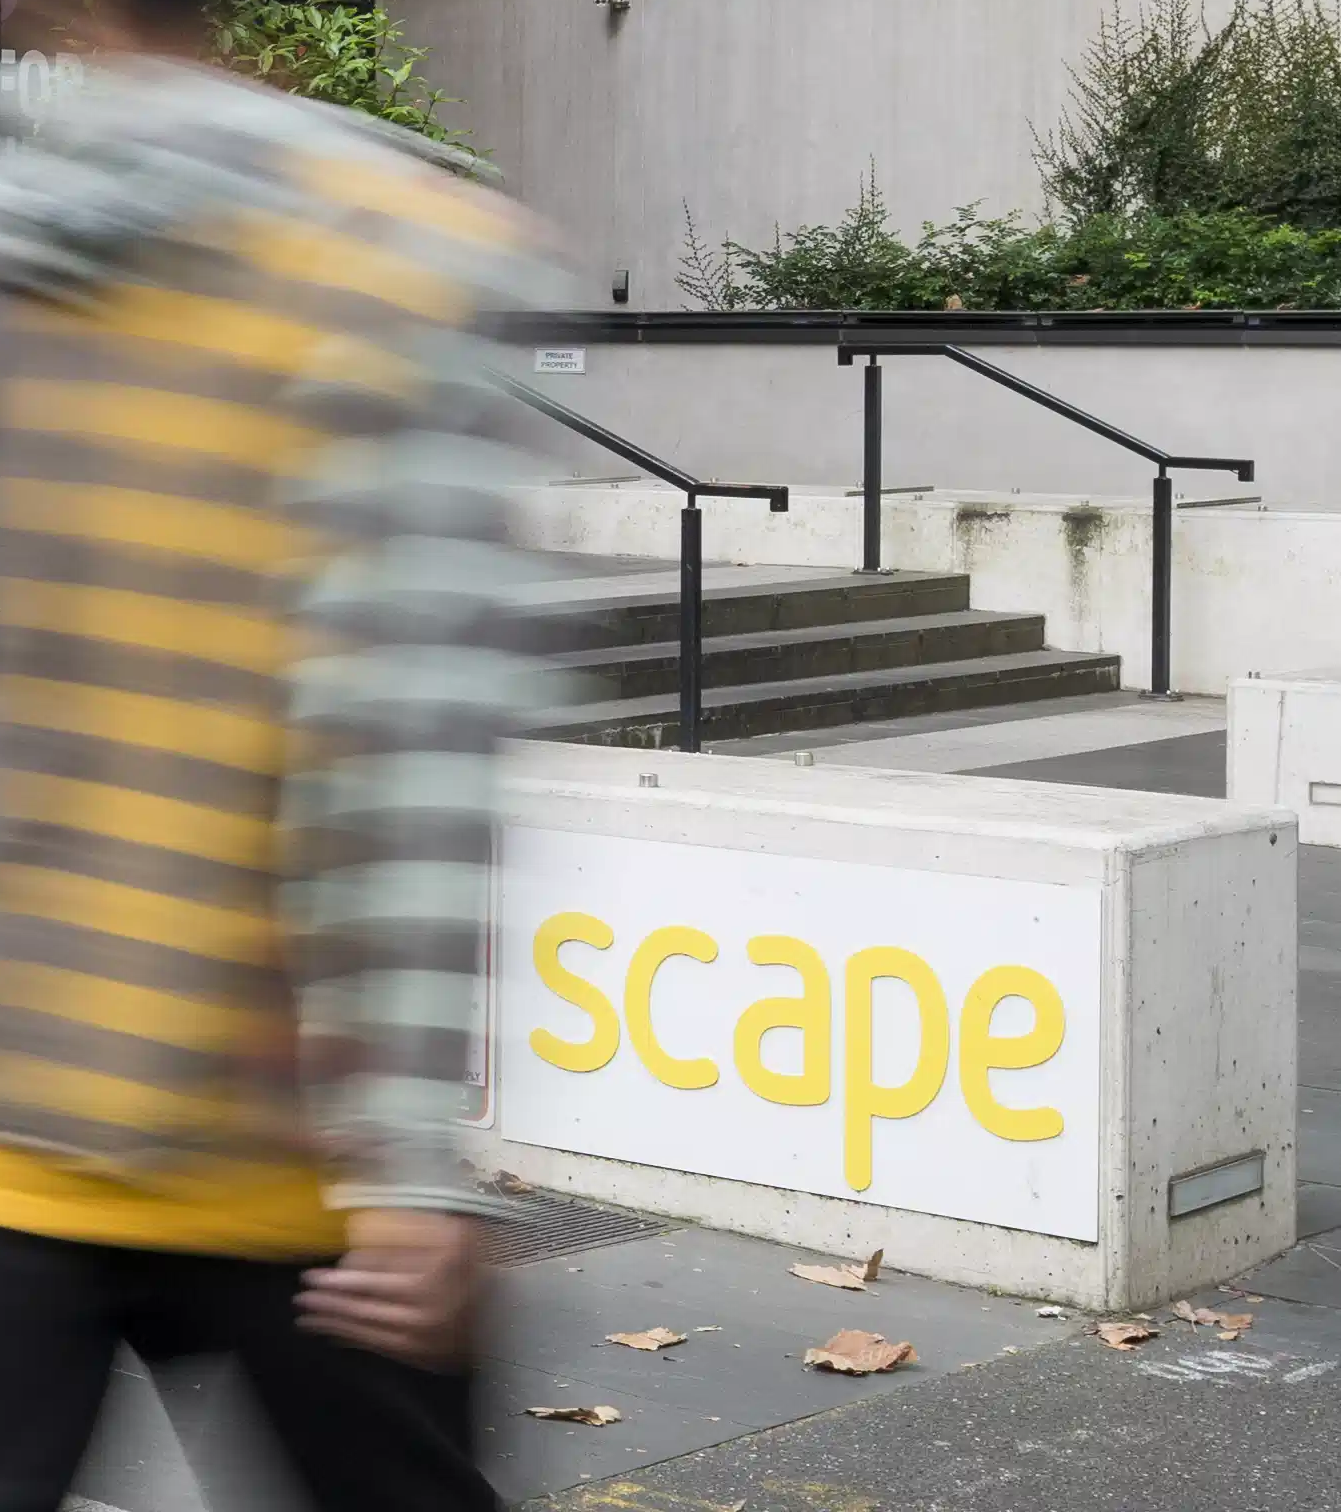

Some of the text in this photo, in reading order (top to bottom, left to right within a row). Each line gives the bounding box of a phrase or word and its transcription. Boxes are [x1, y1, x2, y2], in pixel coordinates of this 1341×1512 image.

[545, 352, 574, 360] PRIVATE
[540, 361, 578, 369] PROPERTY
[528, 911, 1066, 1192] scape
